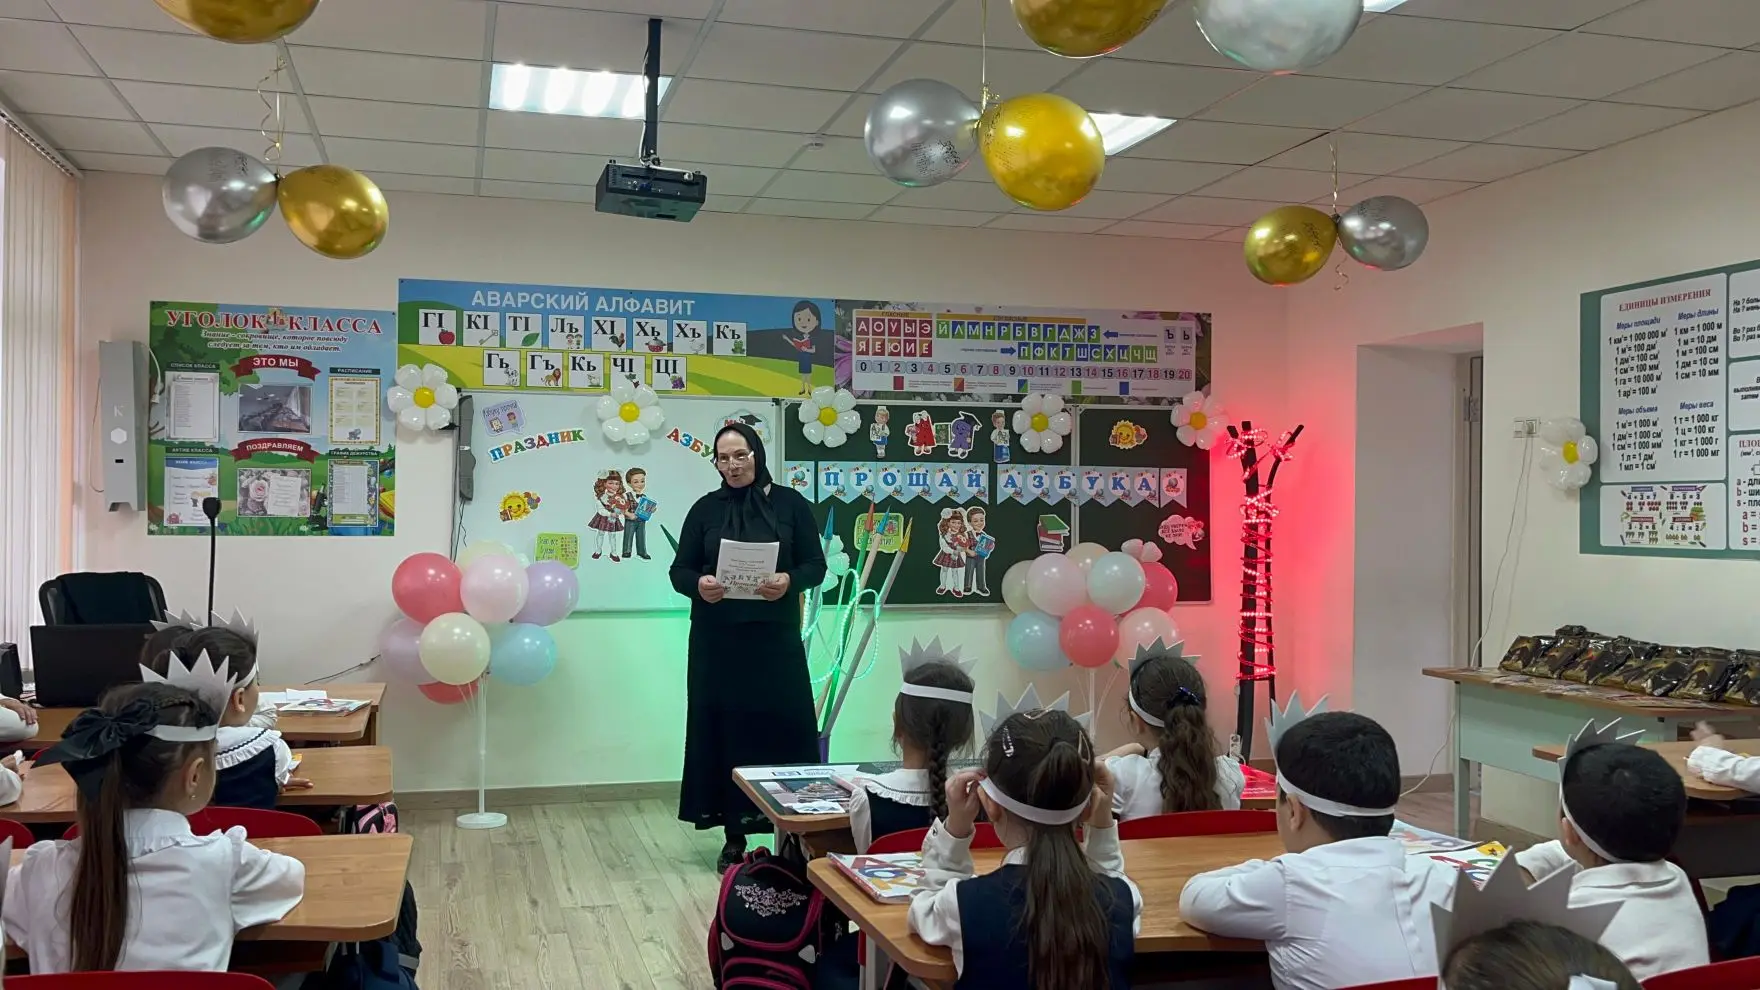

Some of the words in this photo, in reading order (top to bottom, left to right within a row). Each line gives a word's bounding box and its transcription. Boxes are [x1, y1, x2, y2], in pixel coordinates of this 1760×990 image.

[471, 290, 589, 311] АВАРСКИЙ
[595, 297, 695, 315] АЛФАВИТ
[1619, 298, 1658, 311] ЕДИНИЦЫ
[1660, 289, 1711, 304] ИЗМЕРЕНИЯ
[166, 310, 266, 330] УГОЛОК
[288, 316, 382, 334] КЛАССА
[1678, 311, 1696, 320] Меры
[1697, 308, 1718, 317] длины
[675, 322, 701, 338] Хъ
[716, 324, 740, 340] Къ
[1616, 322, 1632, 330] Меры
[1633, 317, 1660, 327] площади
[202, 330, 229, 338] Знание
[252, 357, 276, 367] ЭТО
[279, 358, 299, 367] МЫ
[530, 354, 555, 370] Гъ
[571, 356, 597, 371] Кь
[860, 362, 867, 371] 0
[878, 363, 883, 372] 1
[894, 363, 901, 372] 2
[911, 363, 918, 372] 3
[927, 364, 934, 373] 4
[944, 364, 951, 374] 5
[960, 364, 967, 374] 6
[977, 365, 984, 374] 7
[993, 365, 999, 374] 8
[1009, 366, 1016, 375] 9
[1022, 366, 1034, 376] 10
[1038, 367, 1049, 376] 11
[1054, 367, 1066, 376] 12
[1070, 367, 1082, 377] 13
[1085, 368, 1097, 377] 14
[1102, 368, 1113, 377] 15
[1117, 368, 1128, 378] 16
[1132, 368, 1144, 378] 17
[1148, 369, 1159, 379] 18
[1163, 369, 1175, 379] 19
[1178, 370, 1191, 379] 20
[1680, 402, 1698, 410] Меры
[246, 442, 303, 452] ПОЗДРАВЛЯЕМ
[489, 429, 585, 463] ПРАЗДНИК
[1003, 475, 1152, 491] АЗБУКА
